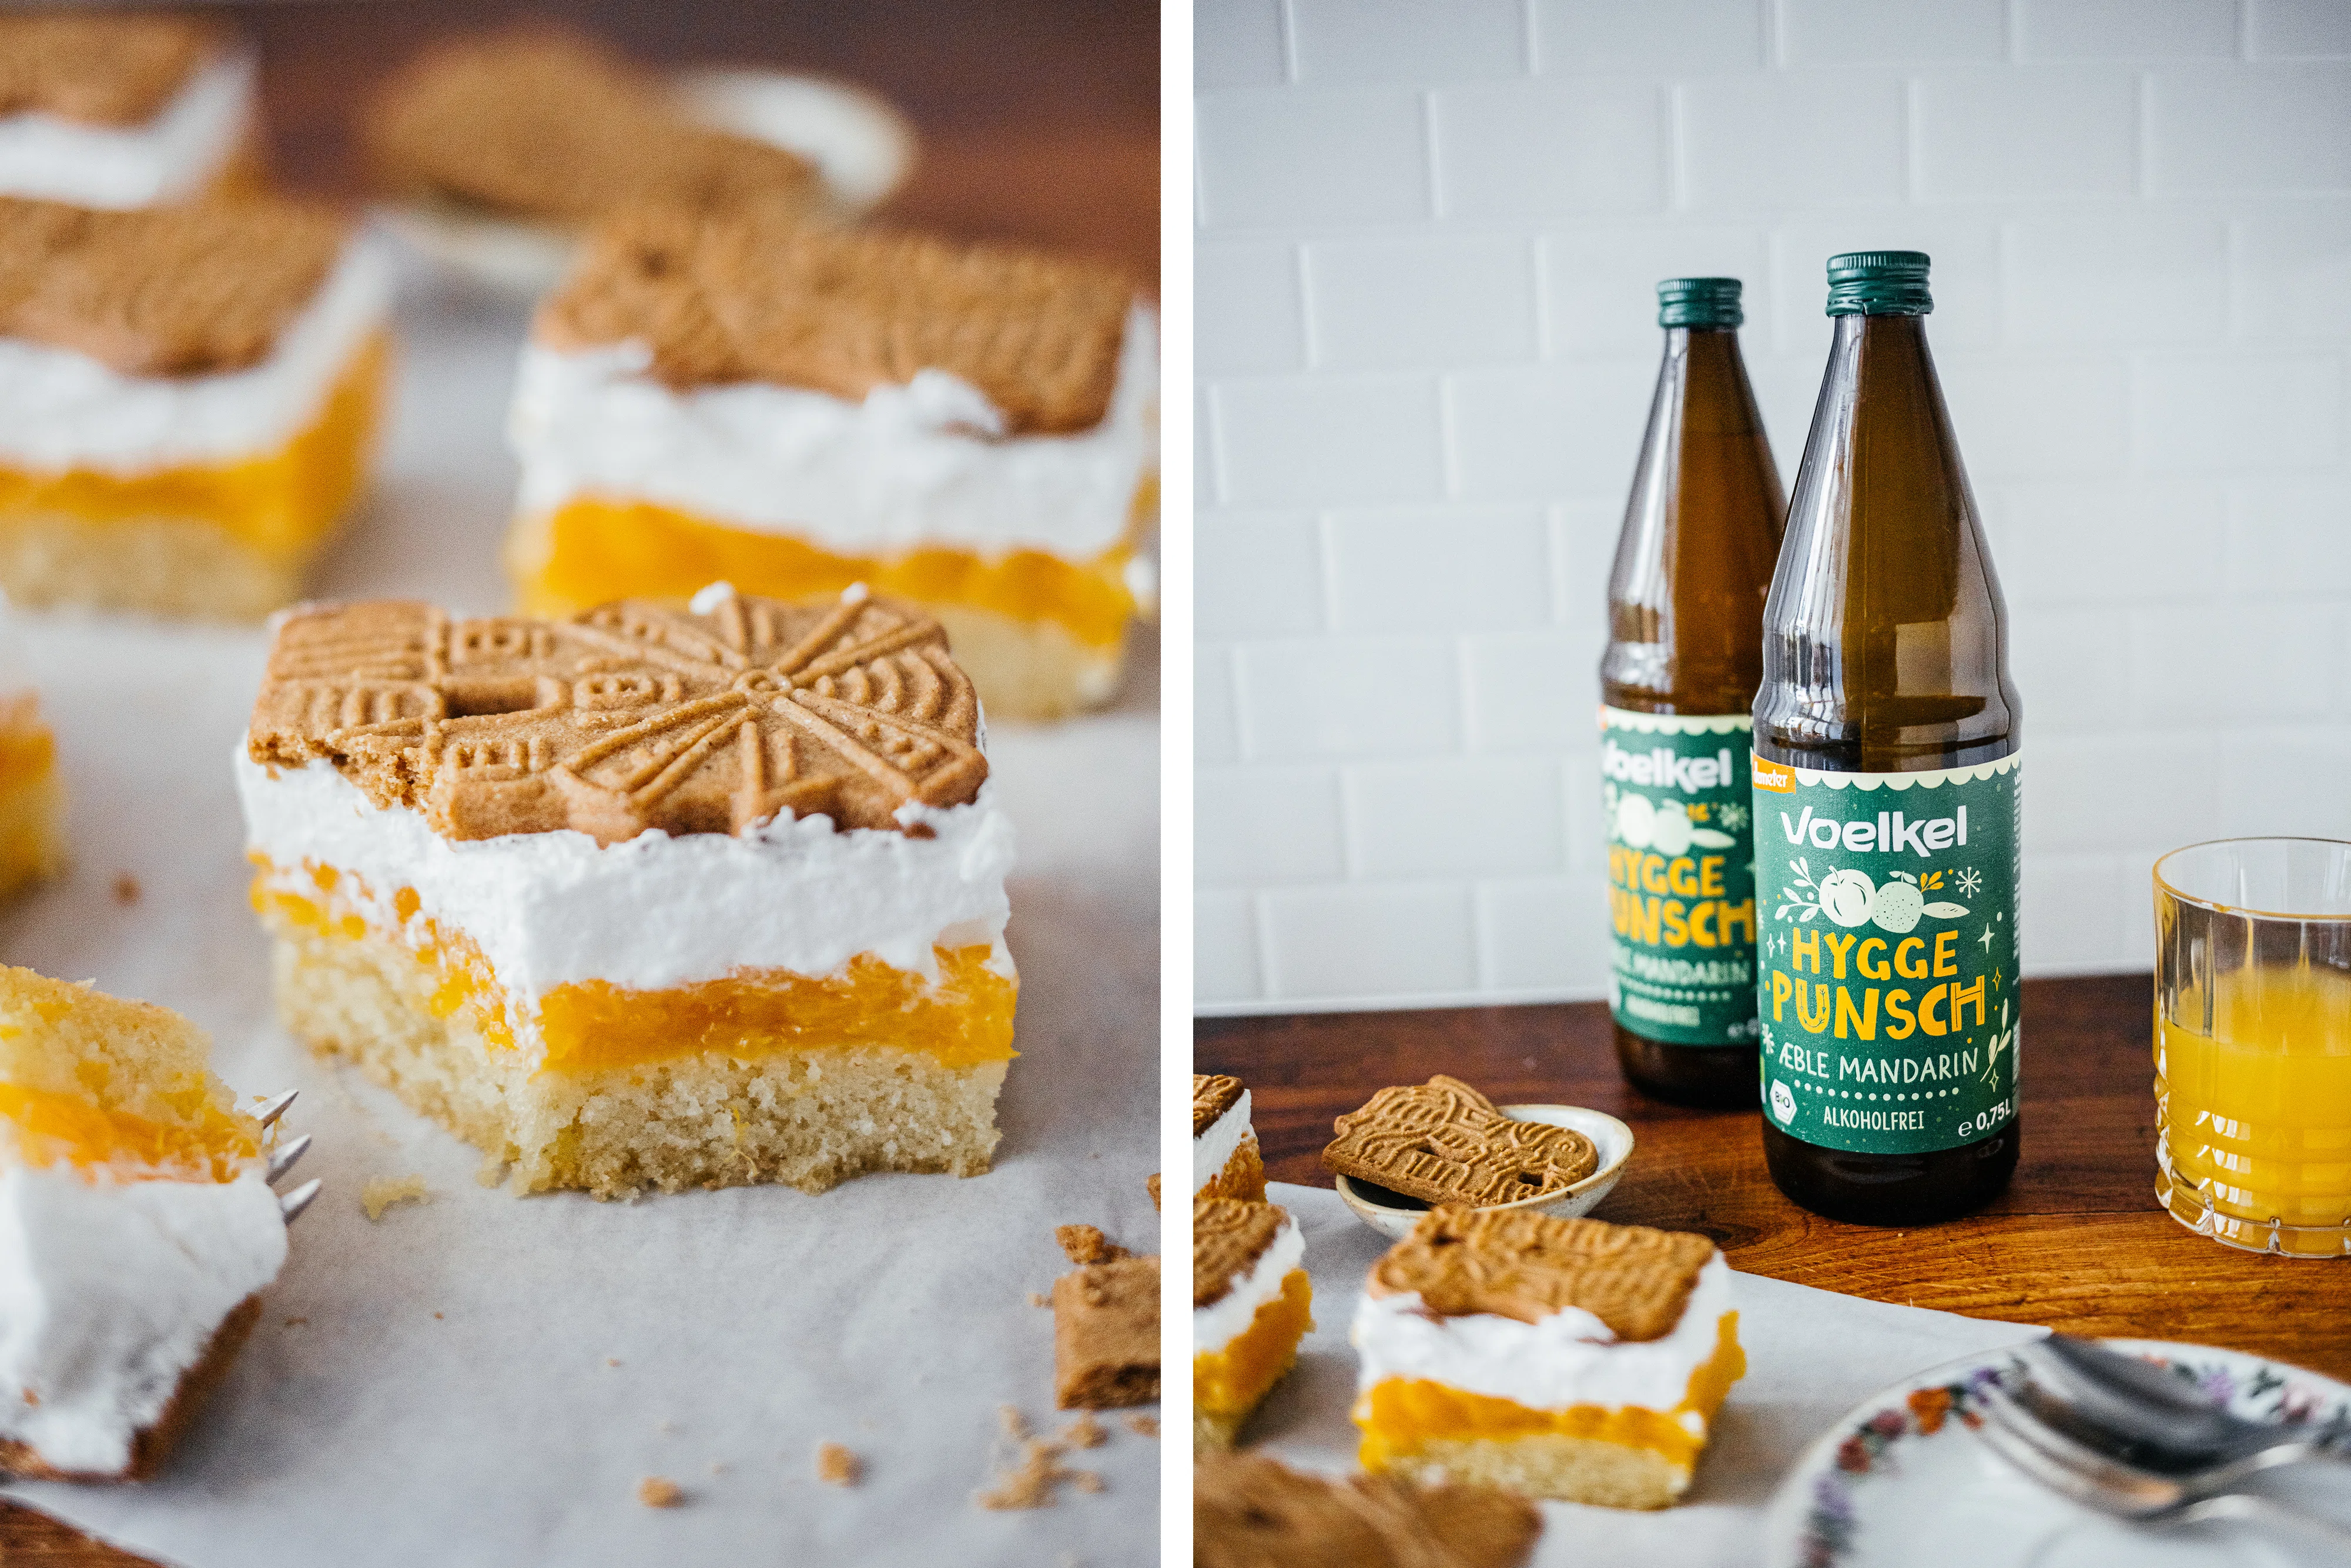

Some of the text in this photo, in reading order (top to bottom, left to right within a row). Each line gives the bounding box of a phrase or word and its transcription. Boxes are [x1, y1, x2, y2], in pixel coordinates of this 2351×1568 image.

[1754, 761, 1788, 788] demeter
[1780, 805, 1967, 857] Voelkel
[1608, 885, 1757, 948] UNSCH
[1792, 927, 1958, 980] HYGGE
[1773, 970, 1985, 1040] PUNSCH
[1779, 1043, 1829, 1078] ÆBLE
[1839, 1047, 1978, 1083] MANDARIN
[1823, 1105, 1925, 1130] ALKOHOLFREI
[1976, 1098, 2011, 1130] 0,75L
